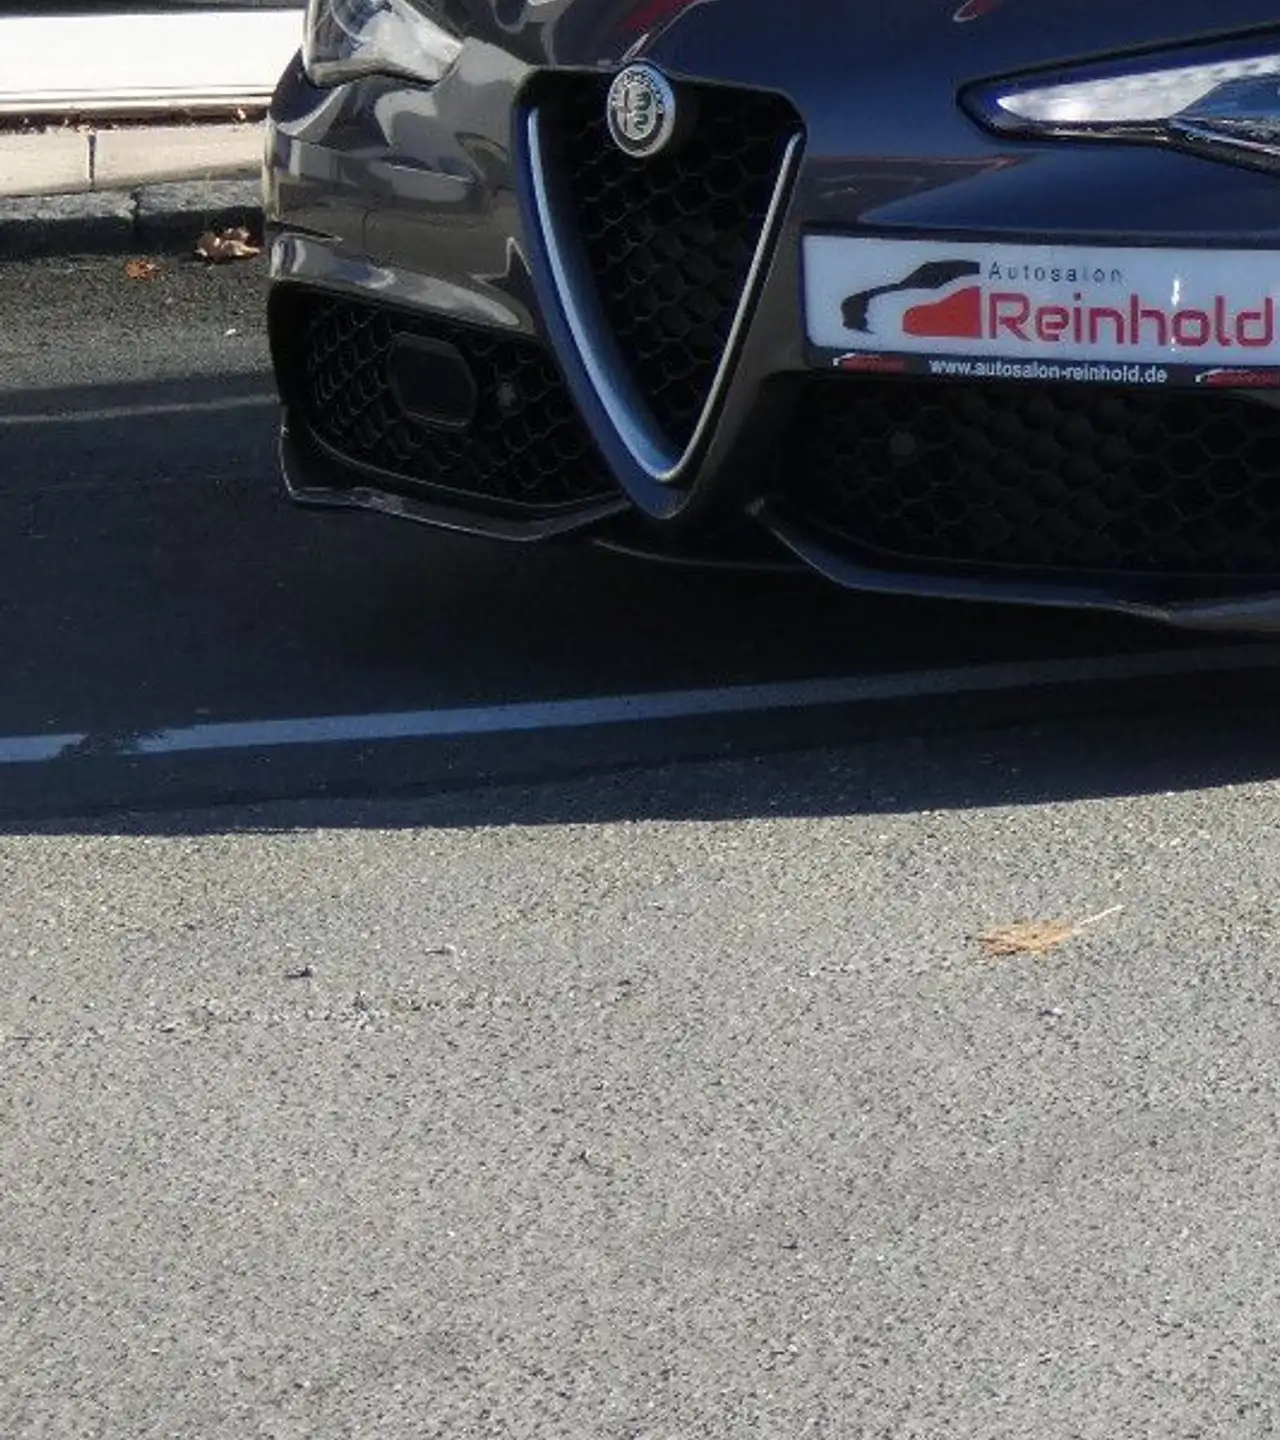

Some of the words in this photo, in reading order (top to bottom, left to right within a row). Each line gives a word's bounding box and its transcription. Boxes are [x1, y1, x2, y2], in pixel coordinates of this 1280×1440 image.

[988, 261, 1124, 285] Autosalon
[988, 291, 1275, 348] Reinhold
[929, 357, 1168, 384] www.autosalon-reinhold.de
